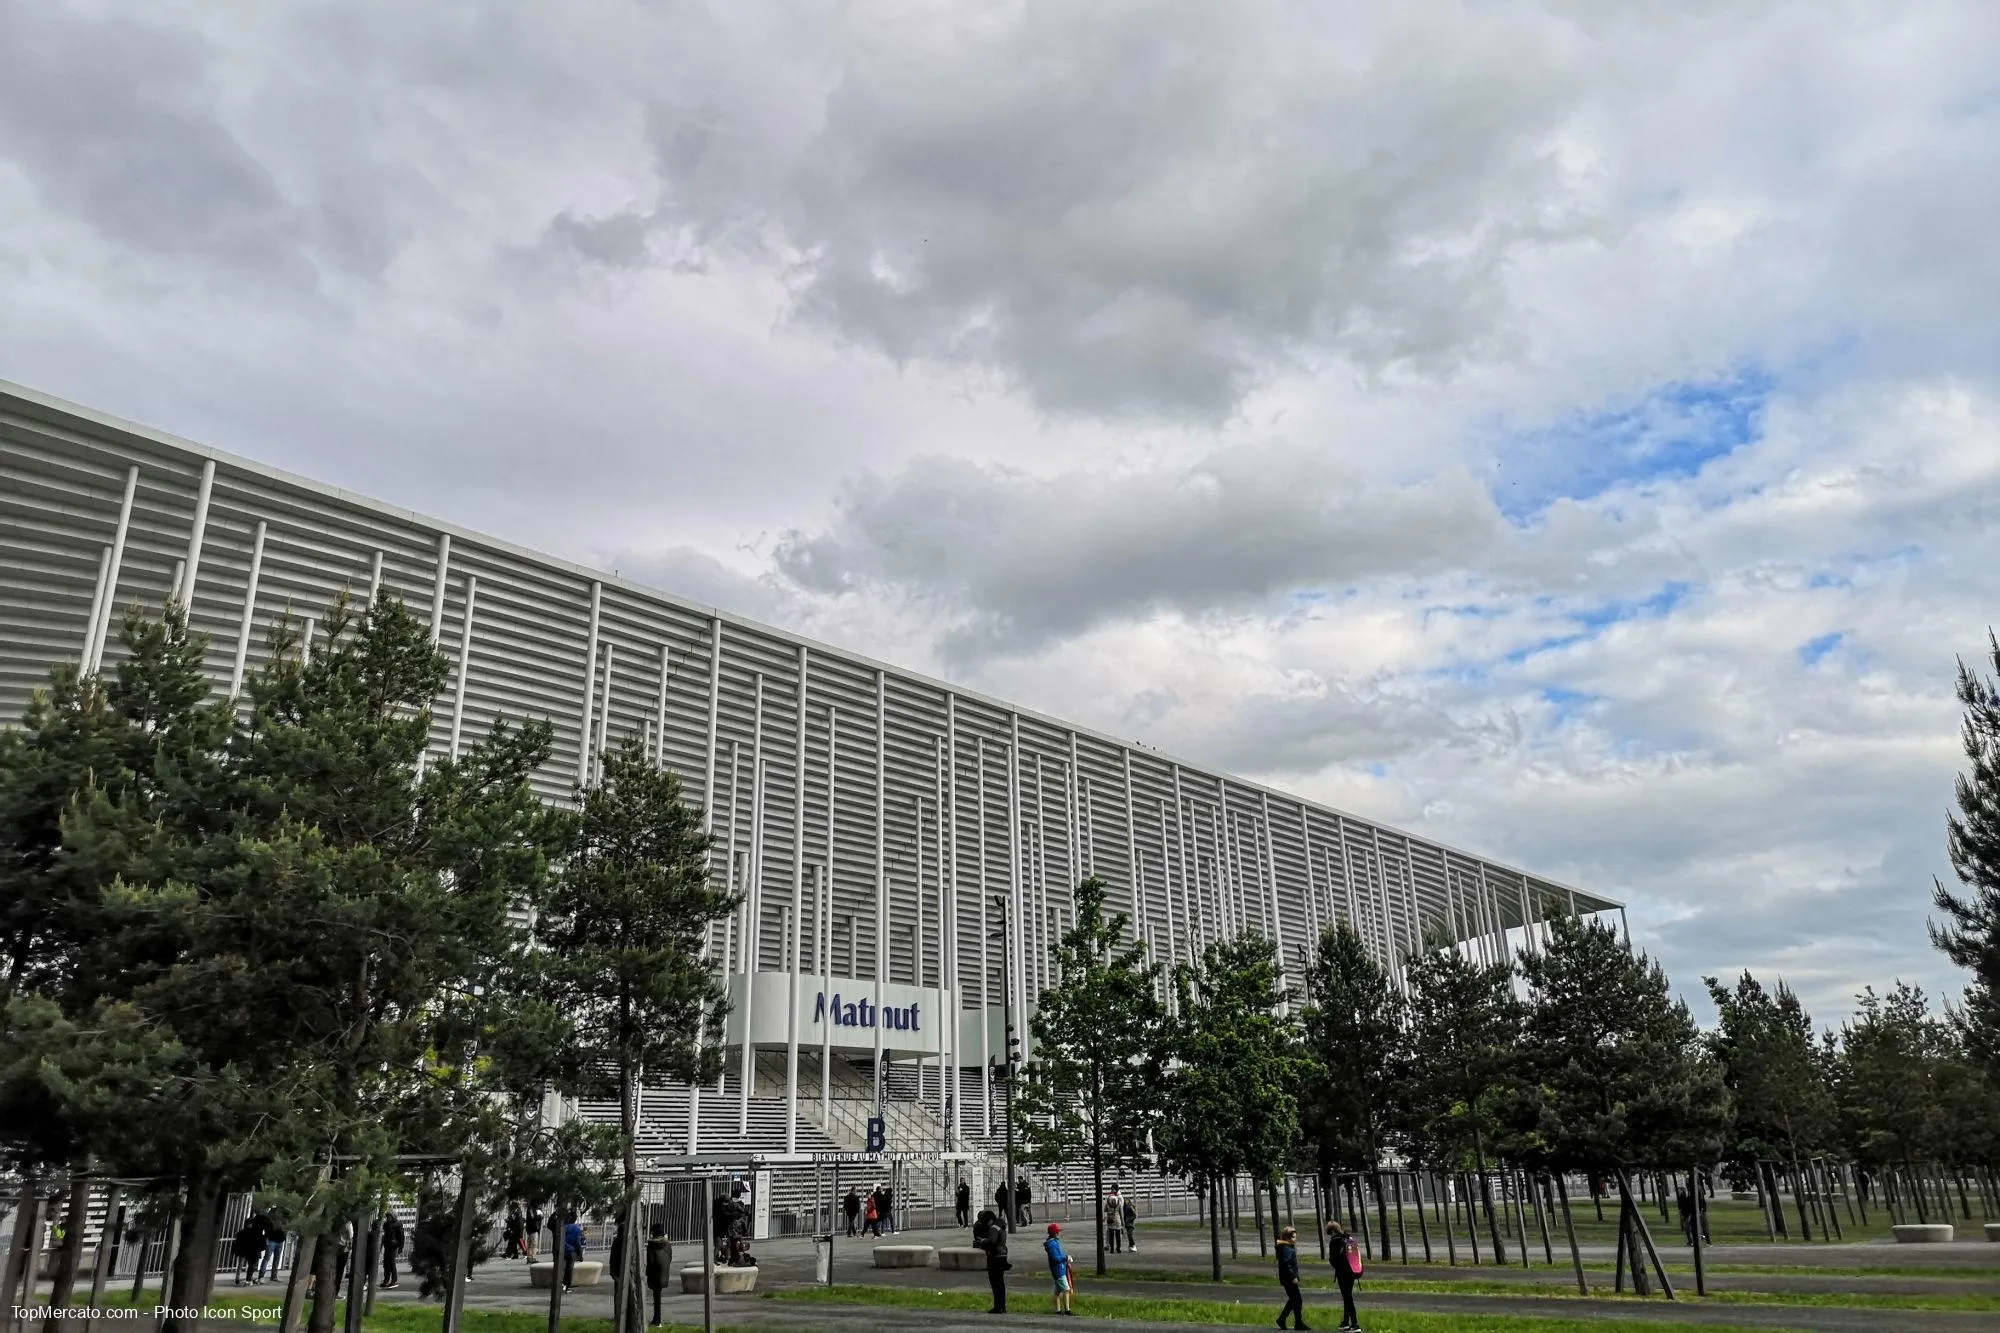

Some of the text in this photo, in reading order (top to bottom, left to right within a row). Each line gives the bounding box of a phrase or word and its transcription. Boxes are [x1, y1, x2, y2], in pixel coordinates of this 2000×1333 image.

[814, 991, 920, 1031] Matmut
[867, 1117, 886, 1152] B
[812, 1152, 942, 1161] BIENVENUE AU MATMUT ATLANTIQUE
